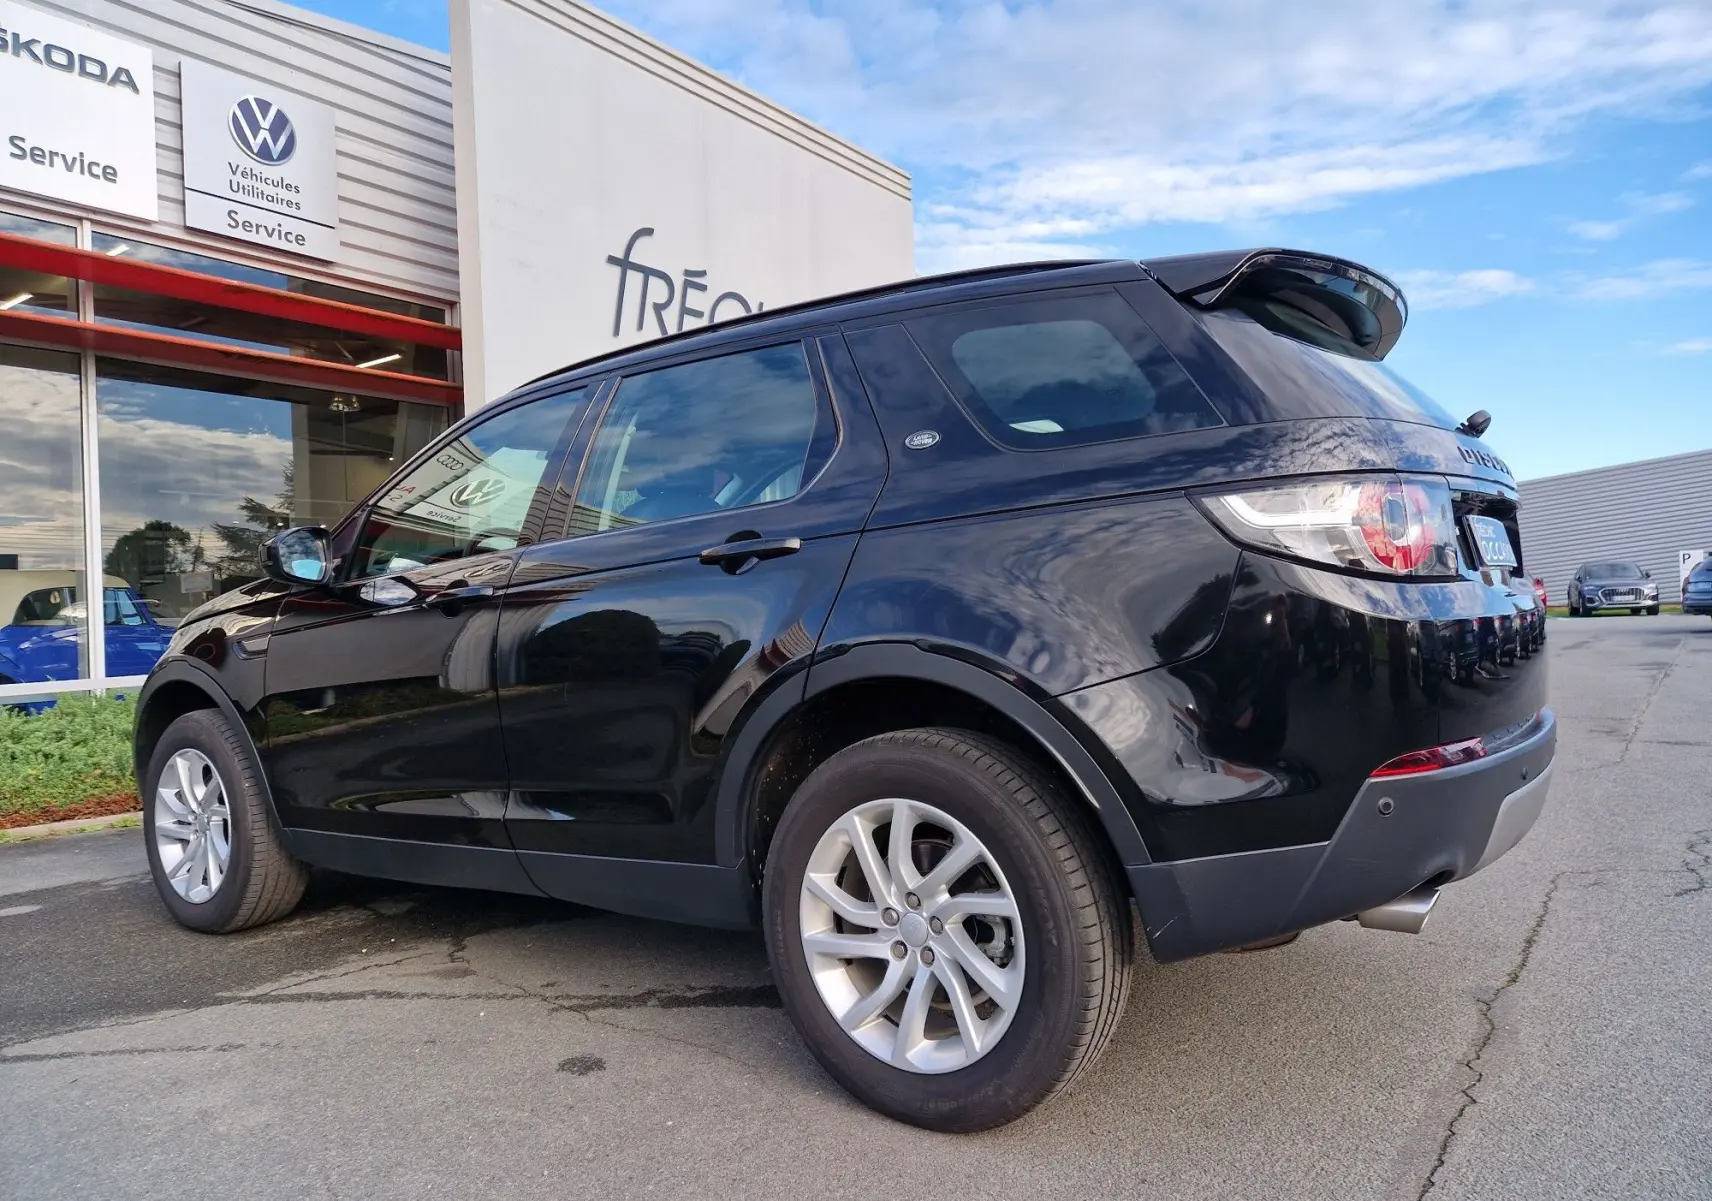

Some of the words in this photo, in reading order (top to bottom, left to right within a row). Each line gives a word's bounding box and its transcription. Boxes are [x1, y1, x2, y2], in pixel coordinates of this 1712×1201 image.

[8, 135, 118, 184] Service
[228, 161, 301, 194] Véhicules
[229, 179, 301, 210] Utilitaires
[227, 209, 306, 246] Service
[1682, 553, 1691, 565] P
